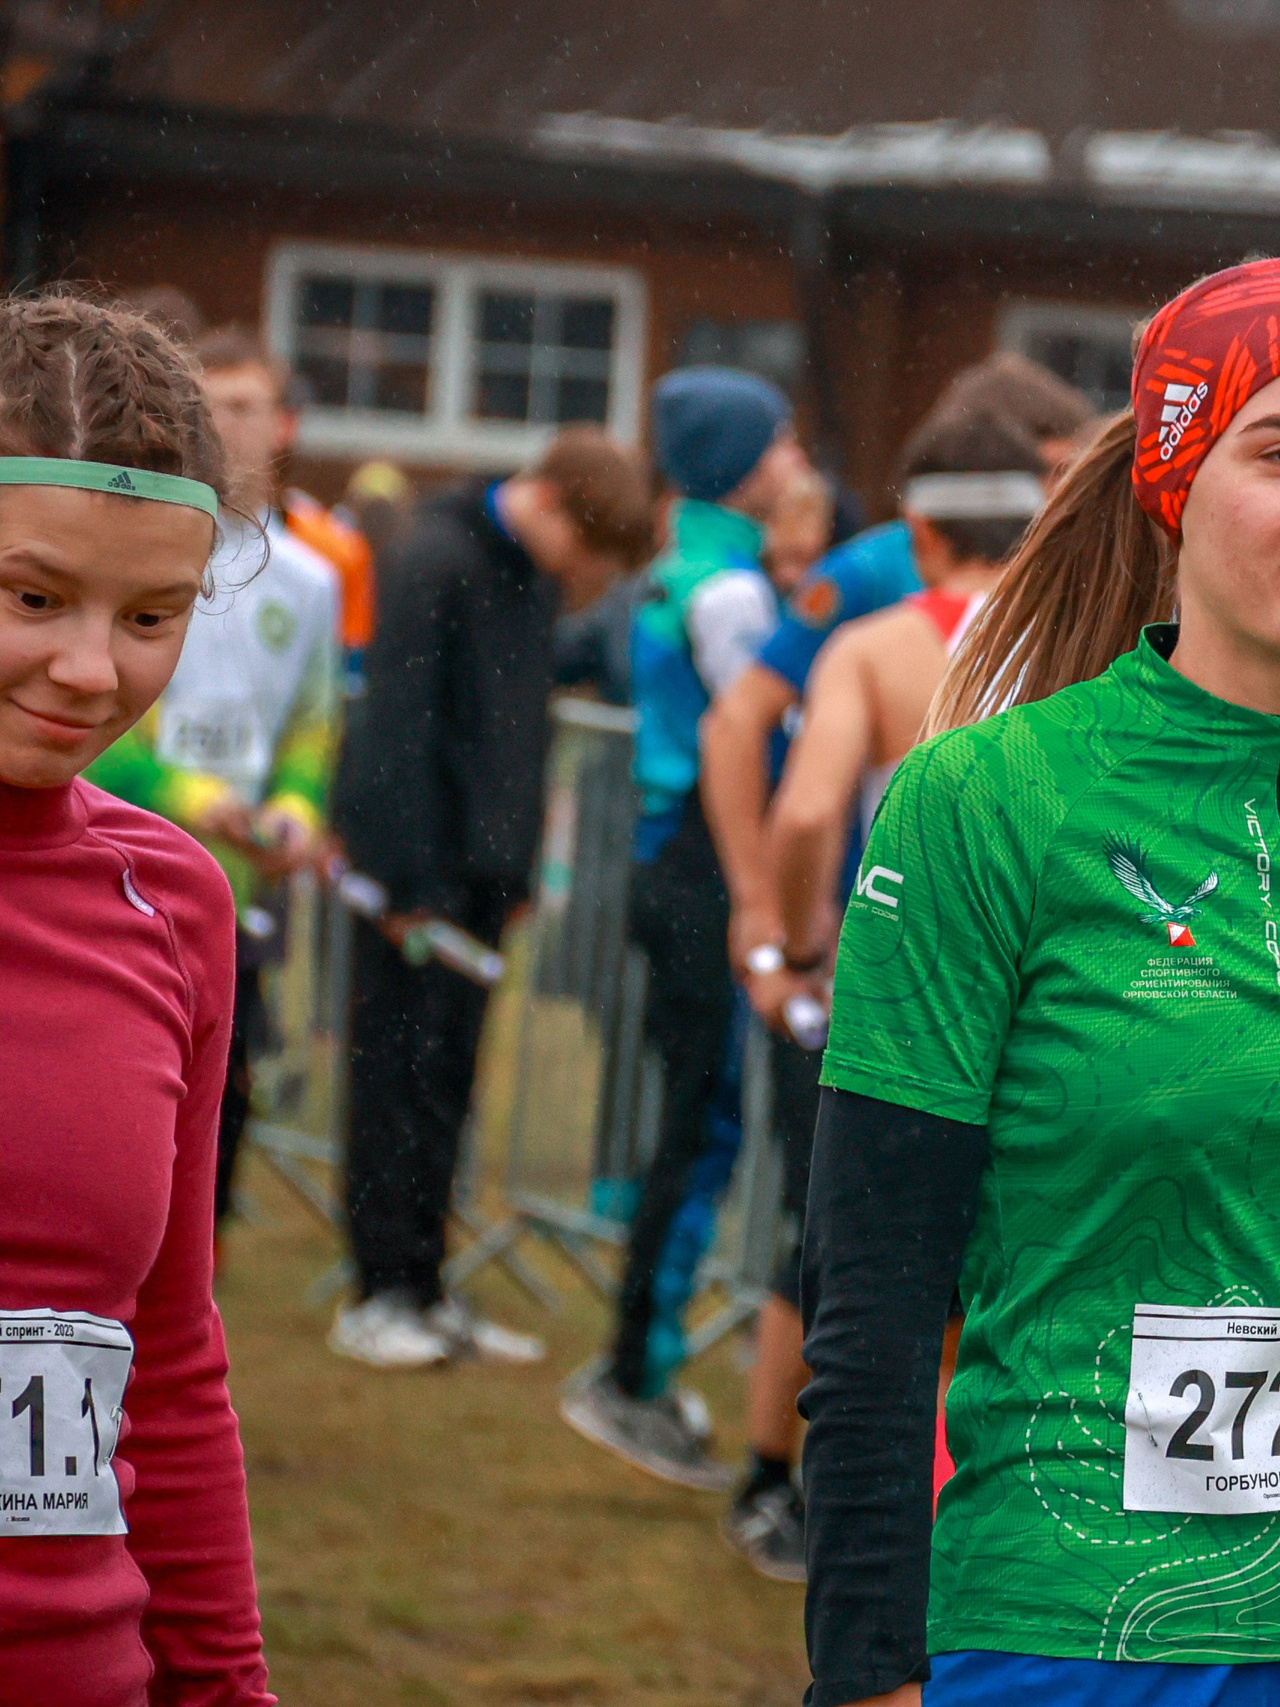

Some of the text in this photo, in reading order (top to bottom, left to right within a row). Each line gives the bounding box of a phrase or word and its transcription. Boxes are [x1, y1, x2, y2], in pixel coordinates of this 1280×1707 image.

[1160, 381, 1209, 461] adidas
[1244, 798, 1272, 908] VICTORY
[1147, 957, 1213, 967] ФЕДЕРАЦИЯ
[1140, 968, 1220, 978] СПОРТИВНОГО
[1130, 979, 1230, 989] ОРИЕНТИРОВАНИЯ
[1122, 989, 1237, 999] ОРЛОВСКОЙ ОБЛАСТИ
[6, 1326, 45, 1339] спринт
[54, 1323, 74, 1337] 2023
[1227, 1322, 1277, 1335] Невский
[0, 1375, 99, 1476] 1.1
[43, 1493, 88, 1510] МАРИЯ
